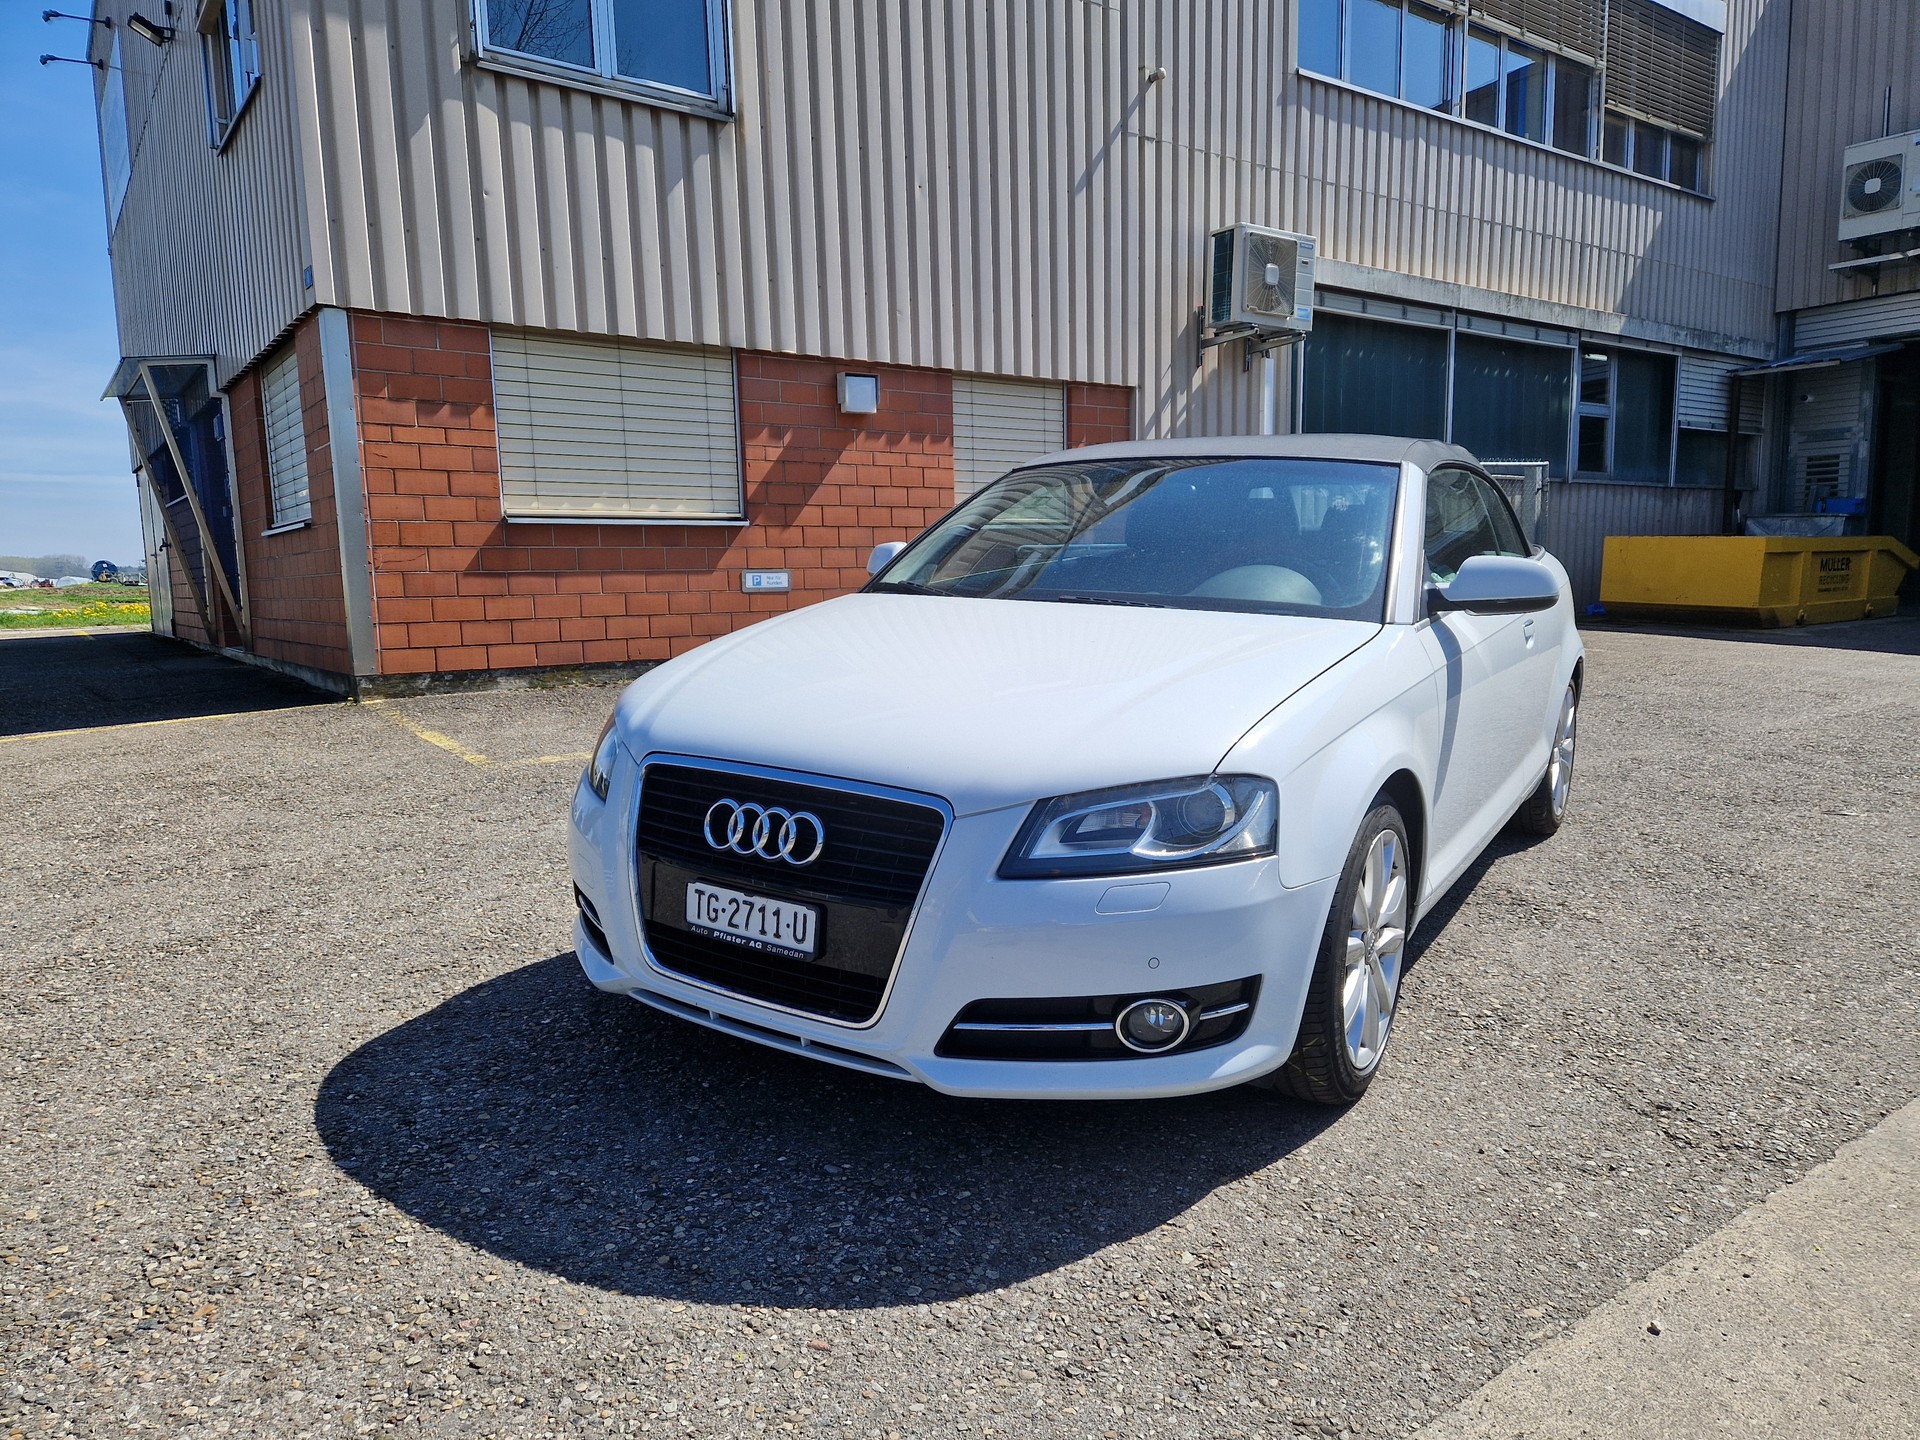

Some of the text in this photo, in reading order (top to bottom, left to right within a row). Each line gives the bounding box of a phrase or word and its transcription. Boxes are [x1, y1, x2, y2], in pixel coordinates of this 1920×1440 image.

[691, 926, 804, 960] Auto Pfister AG Samedan
